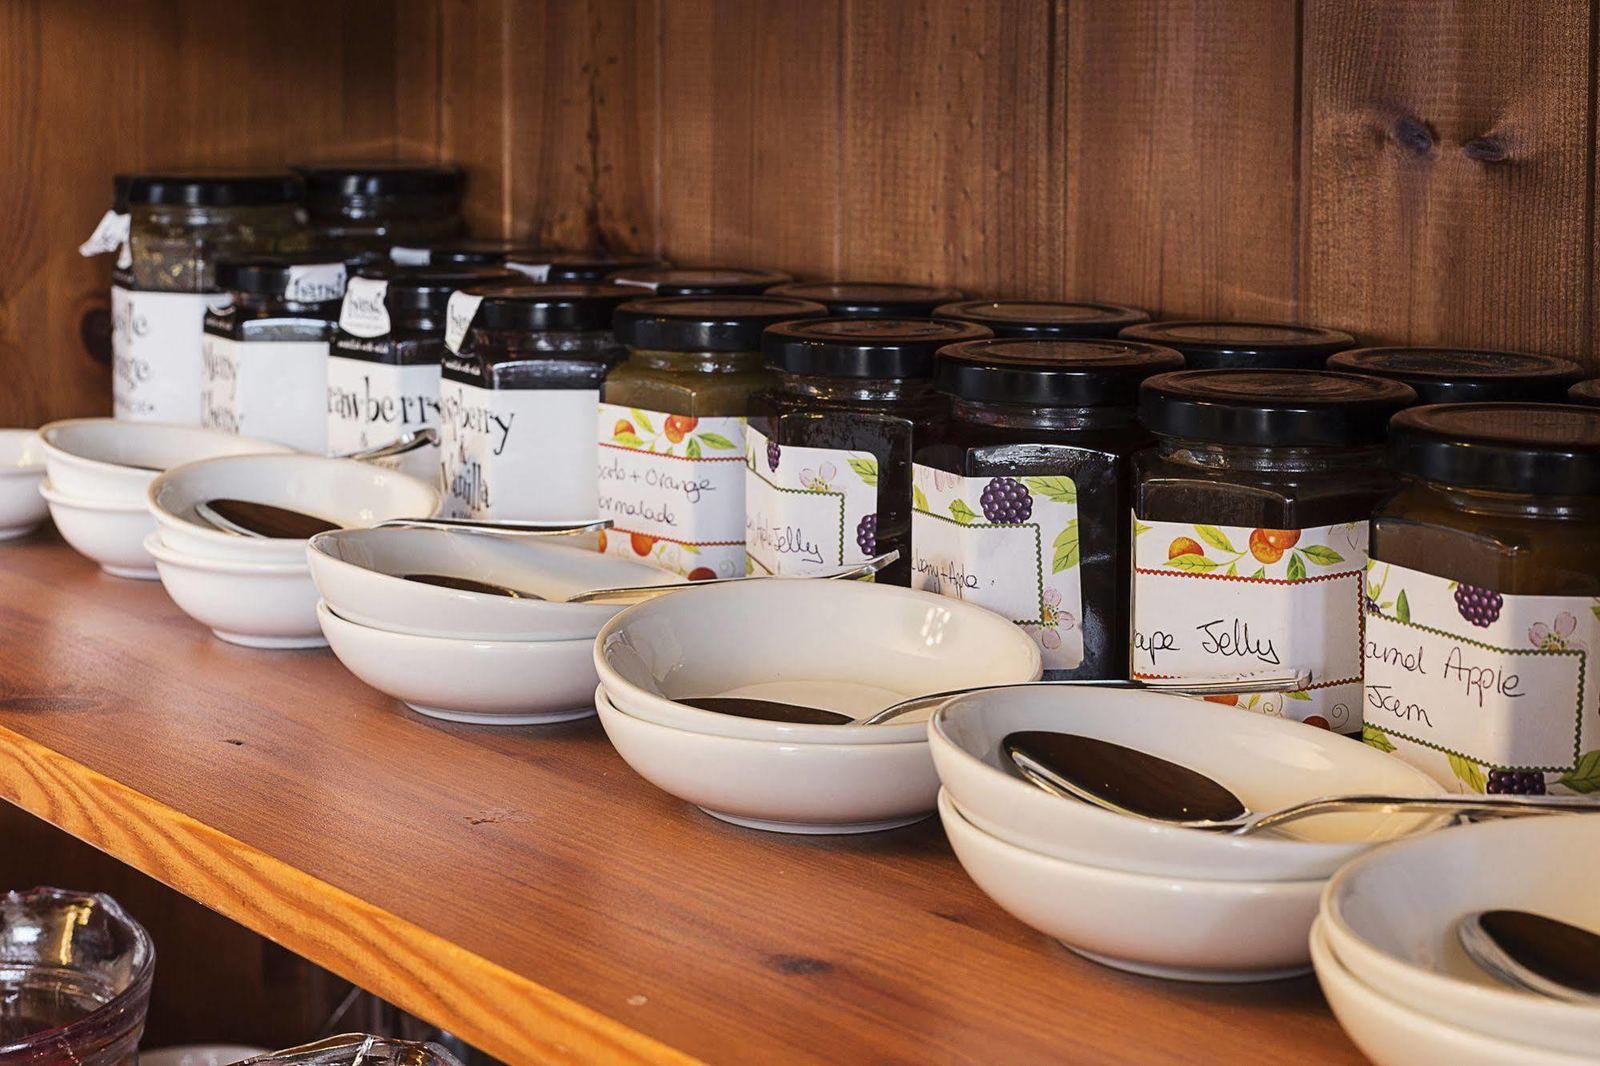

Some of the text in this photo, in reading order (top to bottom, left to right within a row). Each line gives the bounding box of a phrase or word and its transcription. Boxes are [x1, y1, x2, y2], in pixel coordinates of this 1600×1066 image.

[327, 376, 441, 424] rawberr
[645, 468, 717, 505] Orange
[773, 526, 824, 564] Jelly
[1196, 618, 1281, 665] Jelly
[1443, 646, 1526, 708] Apple
